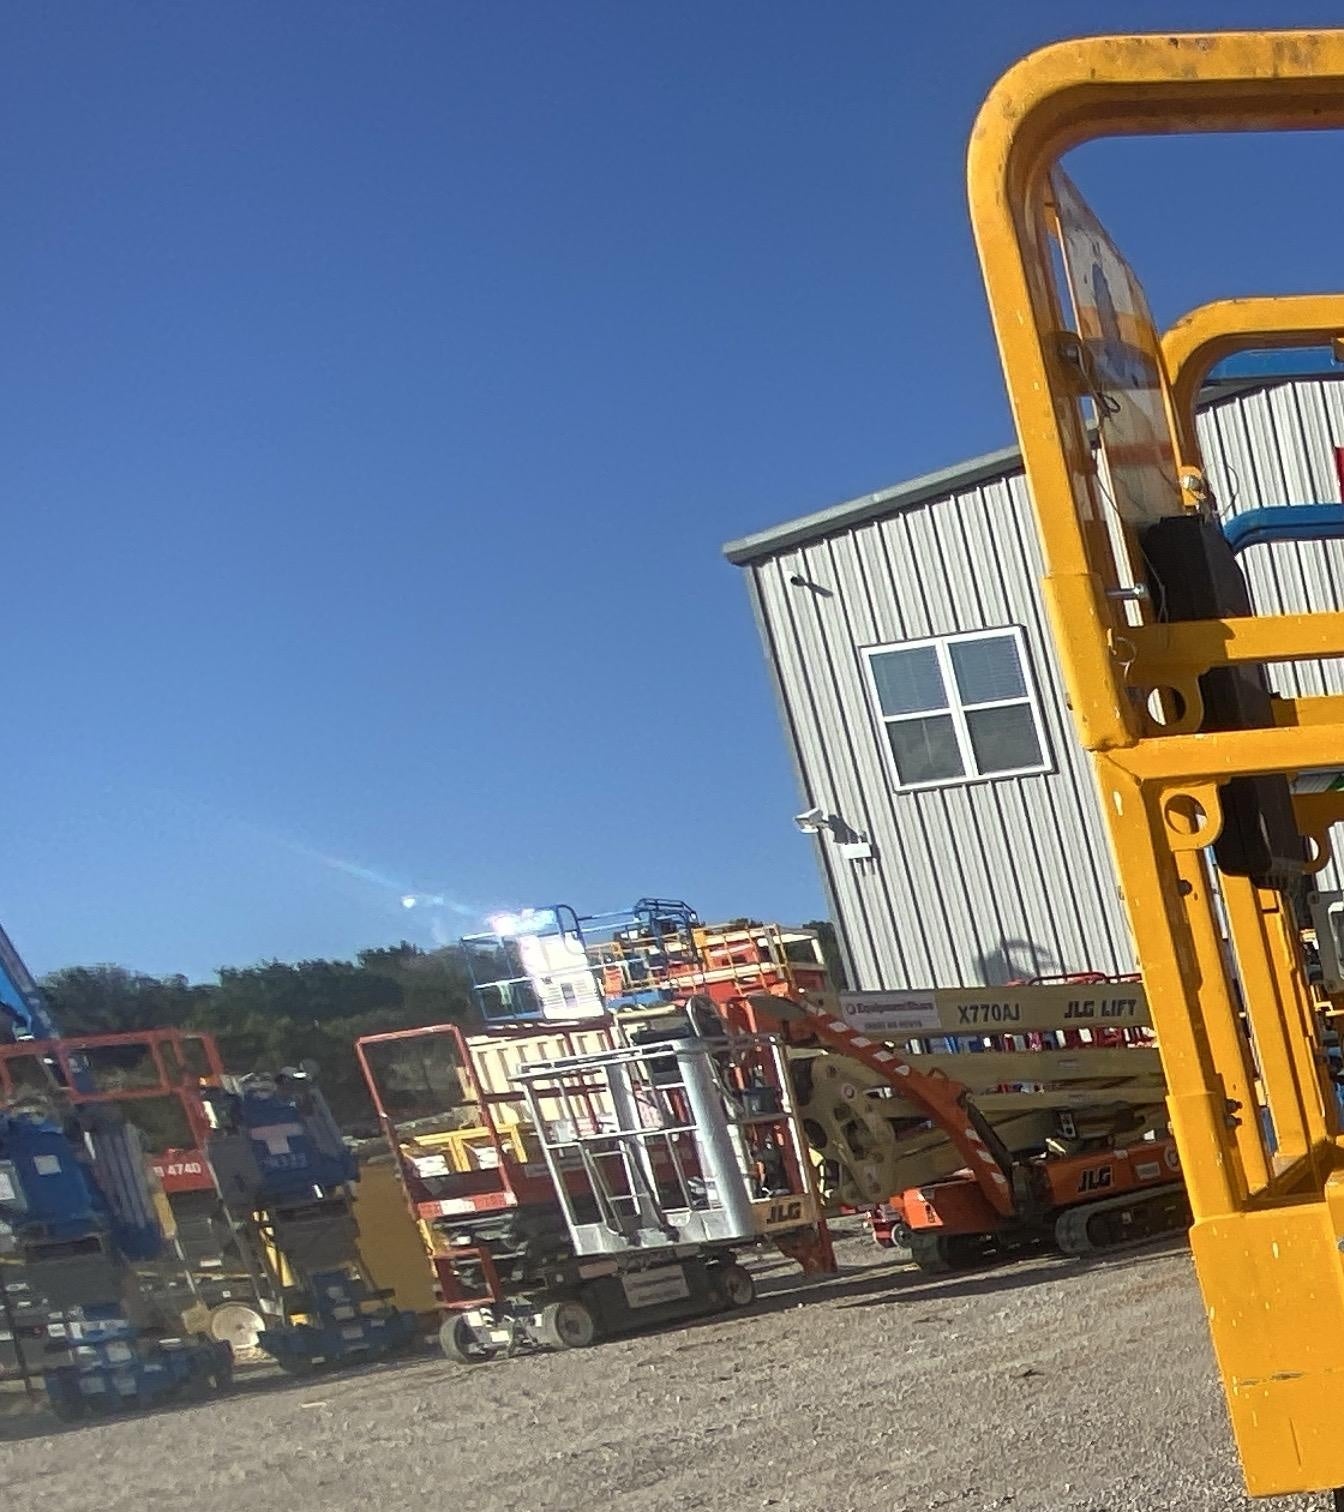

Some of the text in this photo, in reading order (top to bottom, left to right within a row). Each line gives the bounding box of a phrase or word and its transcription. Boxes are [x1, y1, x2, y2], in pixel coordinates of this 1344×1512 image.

[958, 1003, 1020, 1025] X770AJ
[1063, 998, 1137, 1019] JLG LIFT
[168, 1162, 201, 1176] 4740
[1076, 1166, 1112, 1192] JLG
[765, 1201, 800, 1224] JLG
